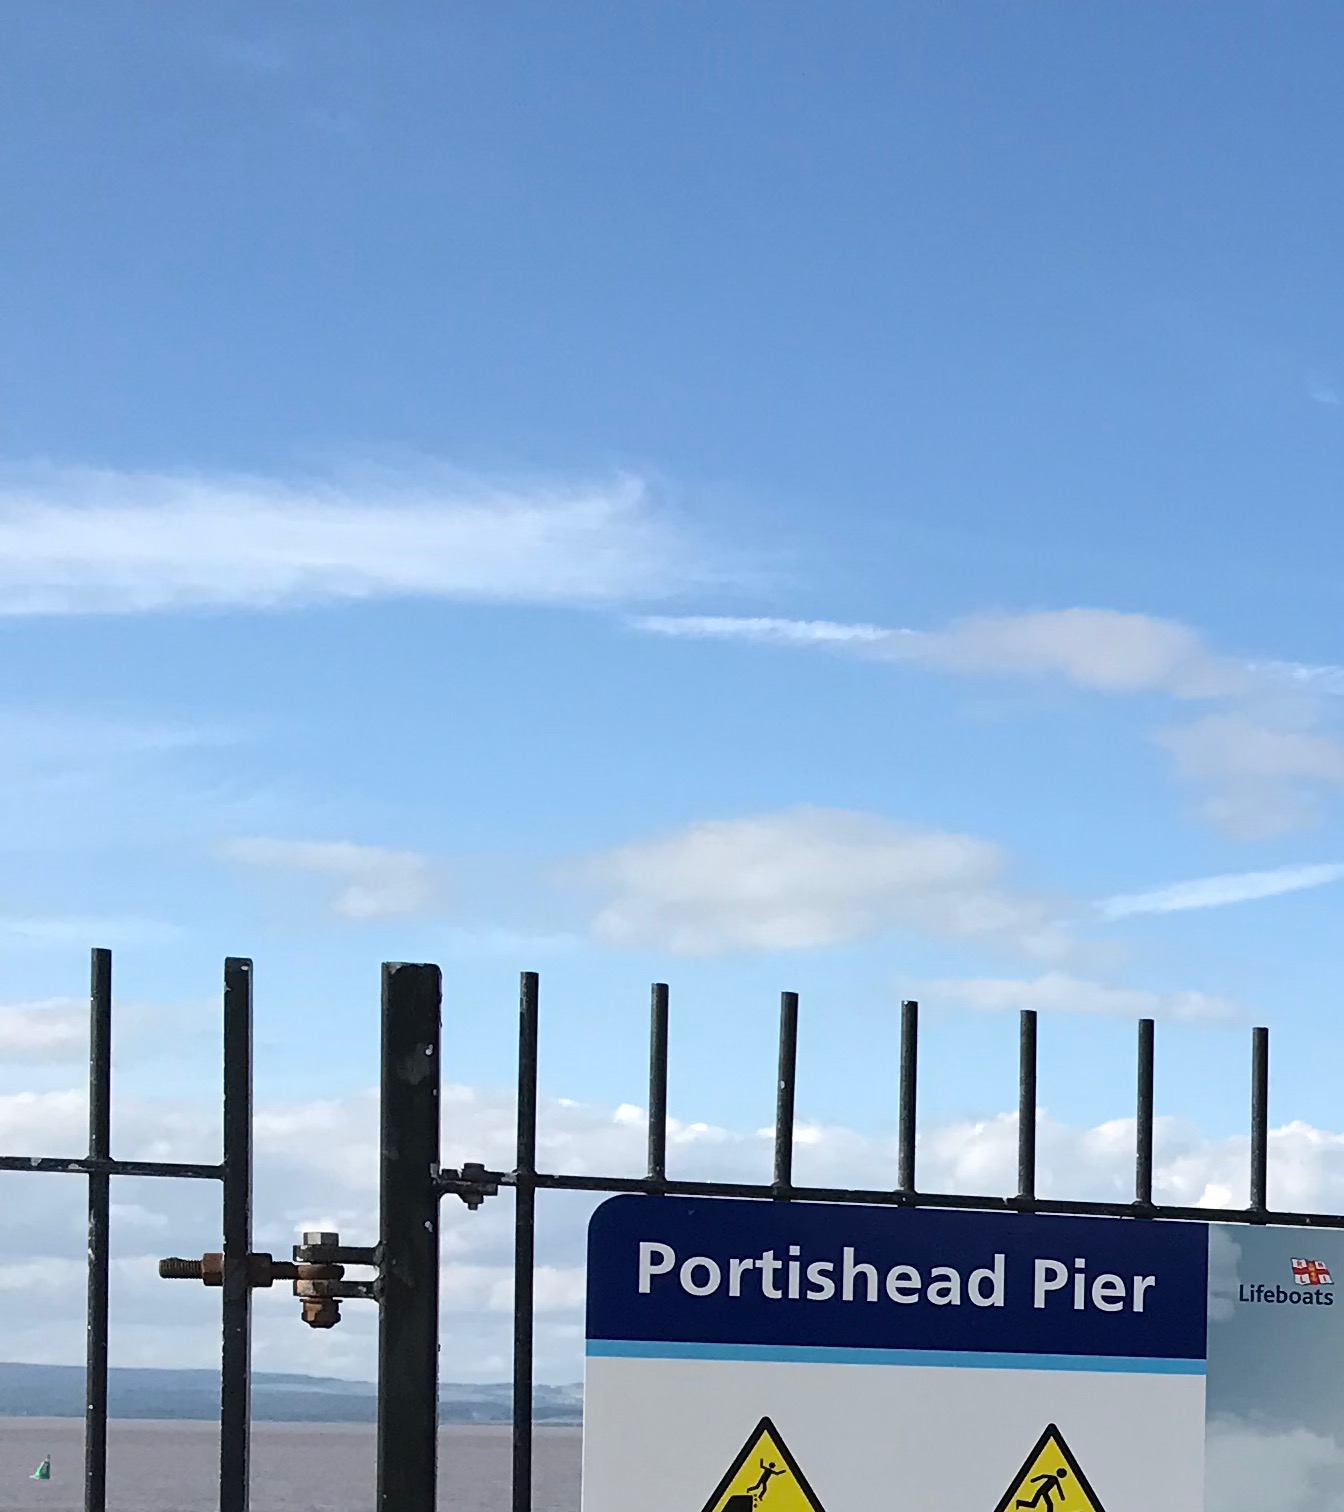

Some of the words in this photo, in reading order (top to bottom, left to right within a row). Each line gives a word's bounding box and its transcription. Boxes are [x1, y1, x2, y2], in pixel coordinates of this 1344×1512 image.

[639, 1241, 1005, 1307] Portishead
[1033, 1258, 1155, 1313] Pier
[1239, 1284, 1334, 1306] Lifeboats
